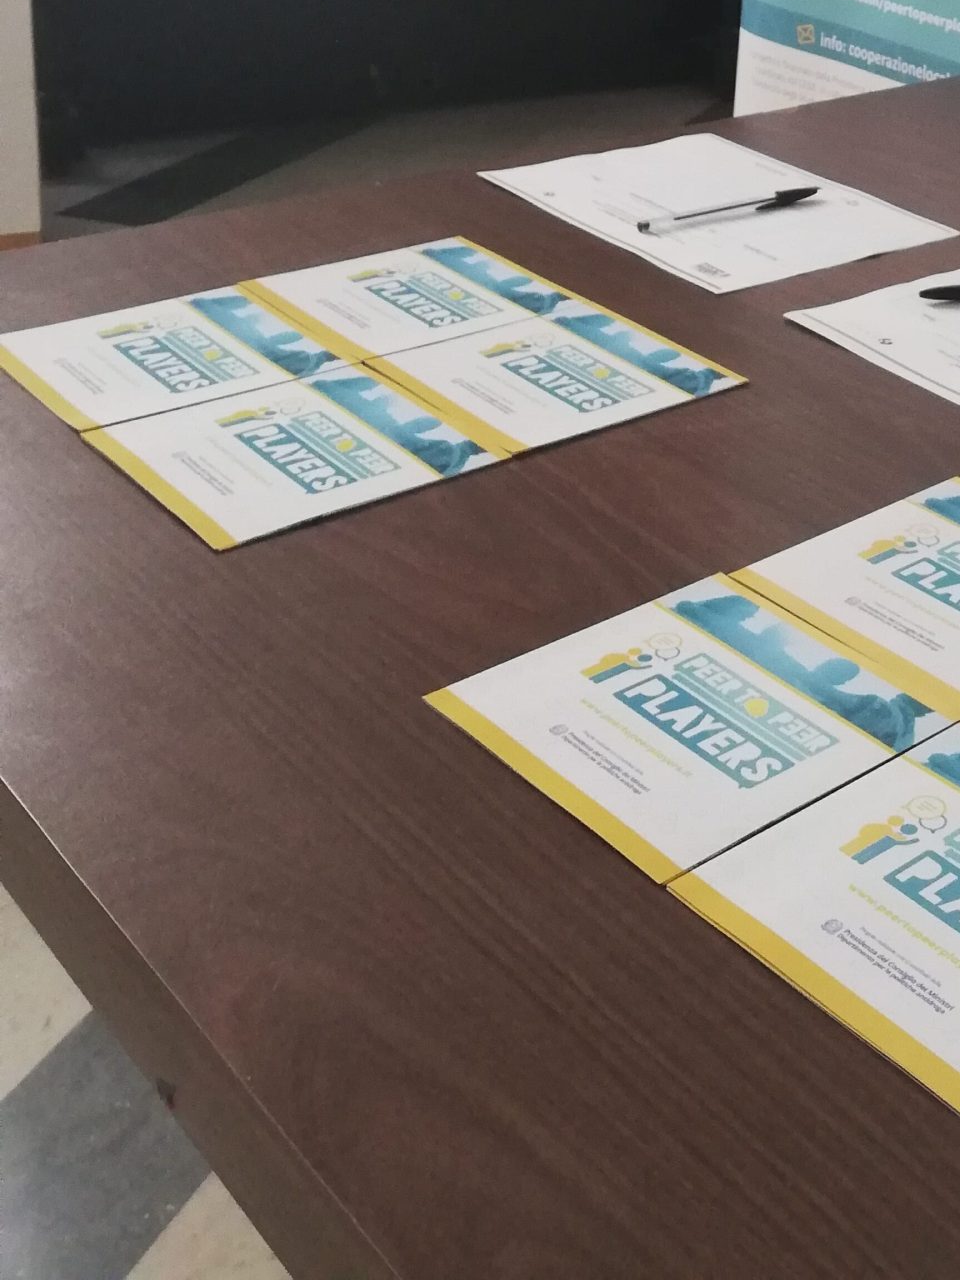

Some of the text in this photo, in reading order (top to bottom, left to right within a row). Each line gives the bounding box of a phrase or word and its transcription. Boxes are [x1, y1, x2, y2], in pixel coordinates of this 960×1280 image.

[508, 355, 613, 412] PLAYERS
[243, 425, 347, 492] PLAYERS
[678, 655, 748, 704] PEER
[624, 676, 784, 784] PLAYERS
